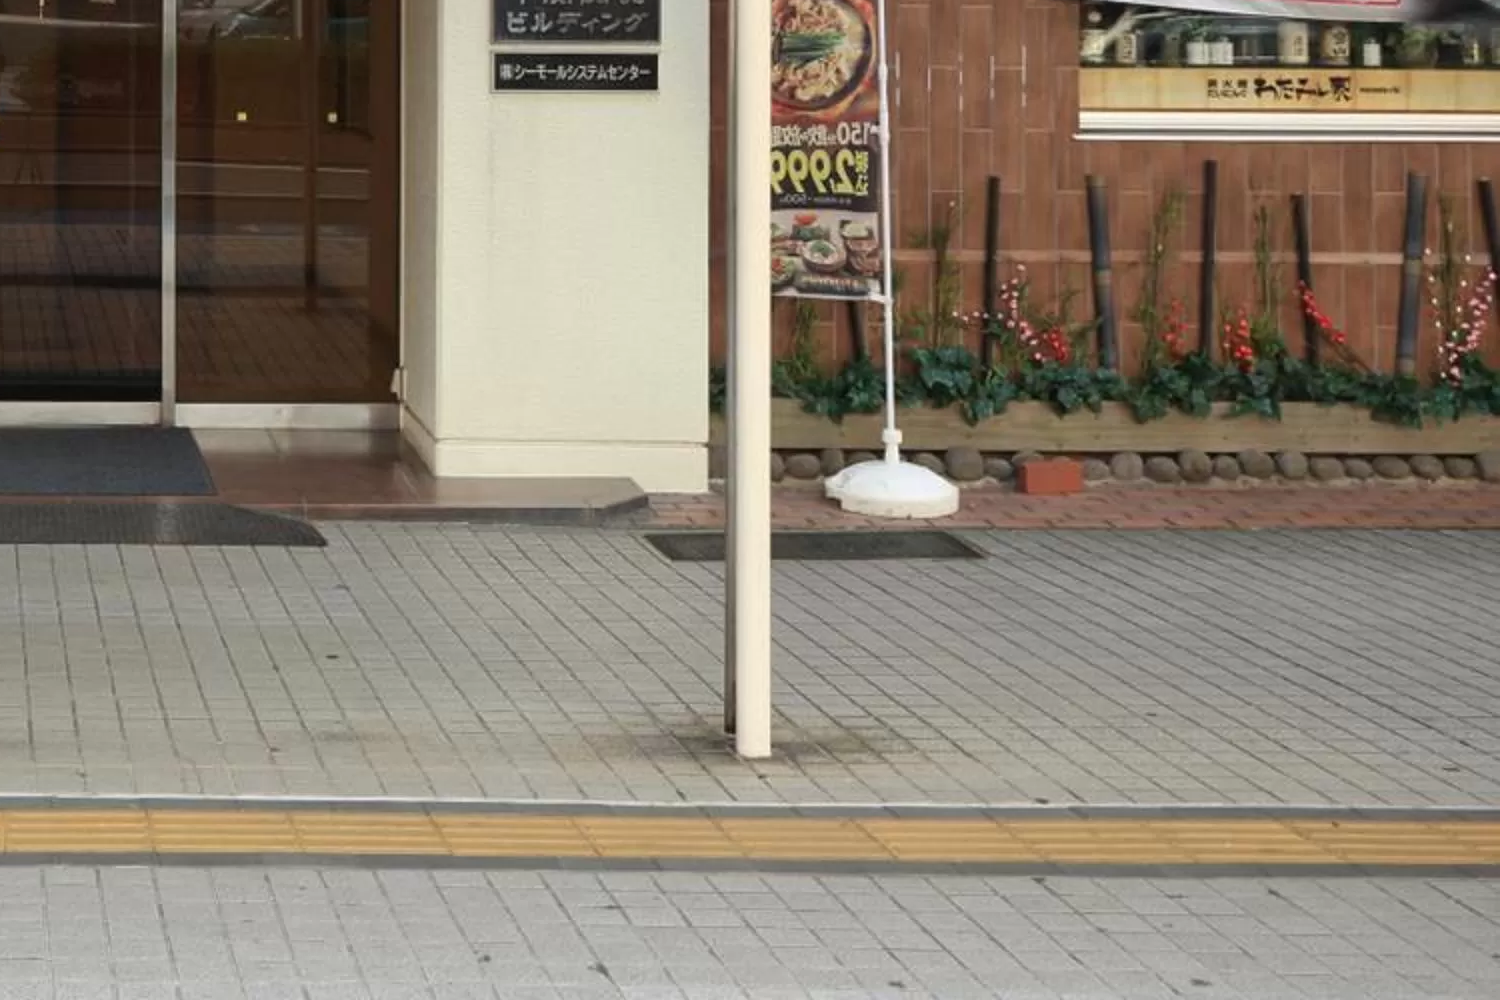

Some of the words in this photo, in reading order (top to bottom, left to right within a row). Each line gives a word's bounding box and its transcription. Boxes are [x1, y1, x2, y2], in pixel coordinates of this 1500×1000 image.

[505, 11, 650, 34] ビルディング
